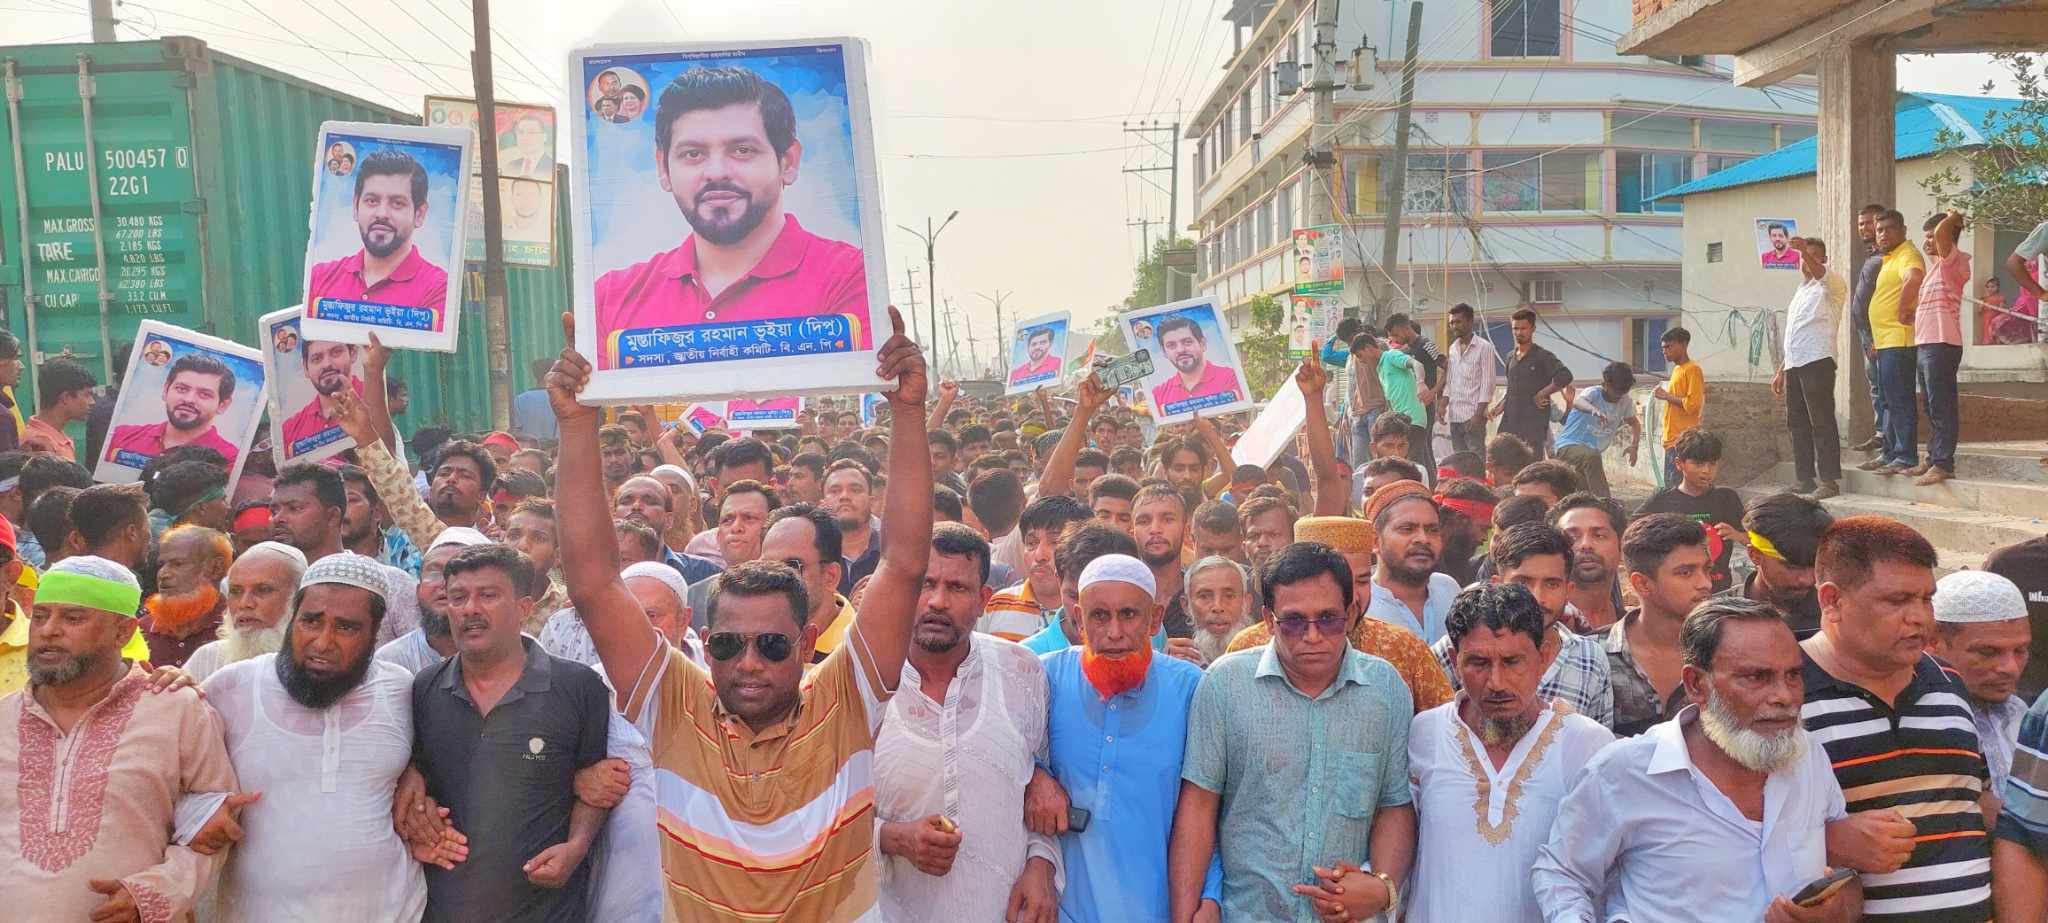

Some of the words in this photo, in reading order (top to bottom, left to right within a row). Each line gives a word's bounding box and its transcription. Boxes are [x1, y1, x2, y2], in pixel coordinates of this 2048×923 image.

[45, 151, 84, 171] PALU
[105, 148, 166, 170] 500457
[176, 146, 189, 168] 0
[109, 175, 149, 196] 22G1
[37, 241, 74, 262] TARE
[625, 328, 695, 352] মুস্তাফিজুর
[702, 326, 748, 343] রহমান
[799, 316, 844, 340] (দিপু)
